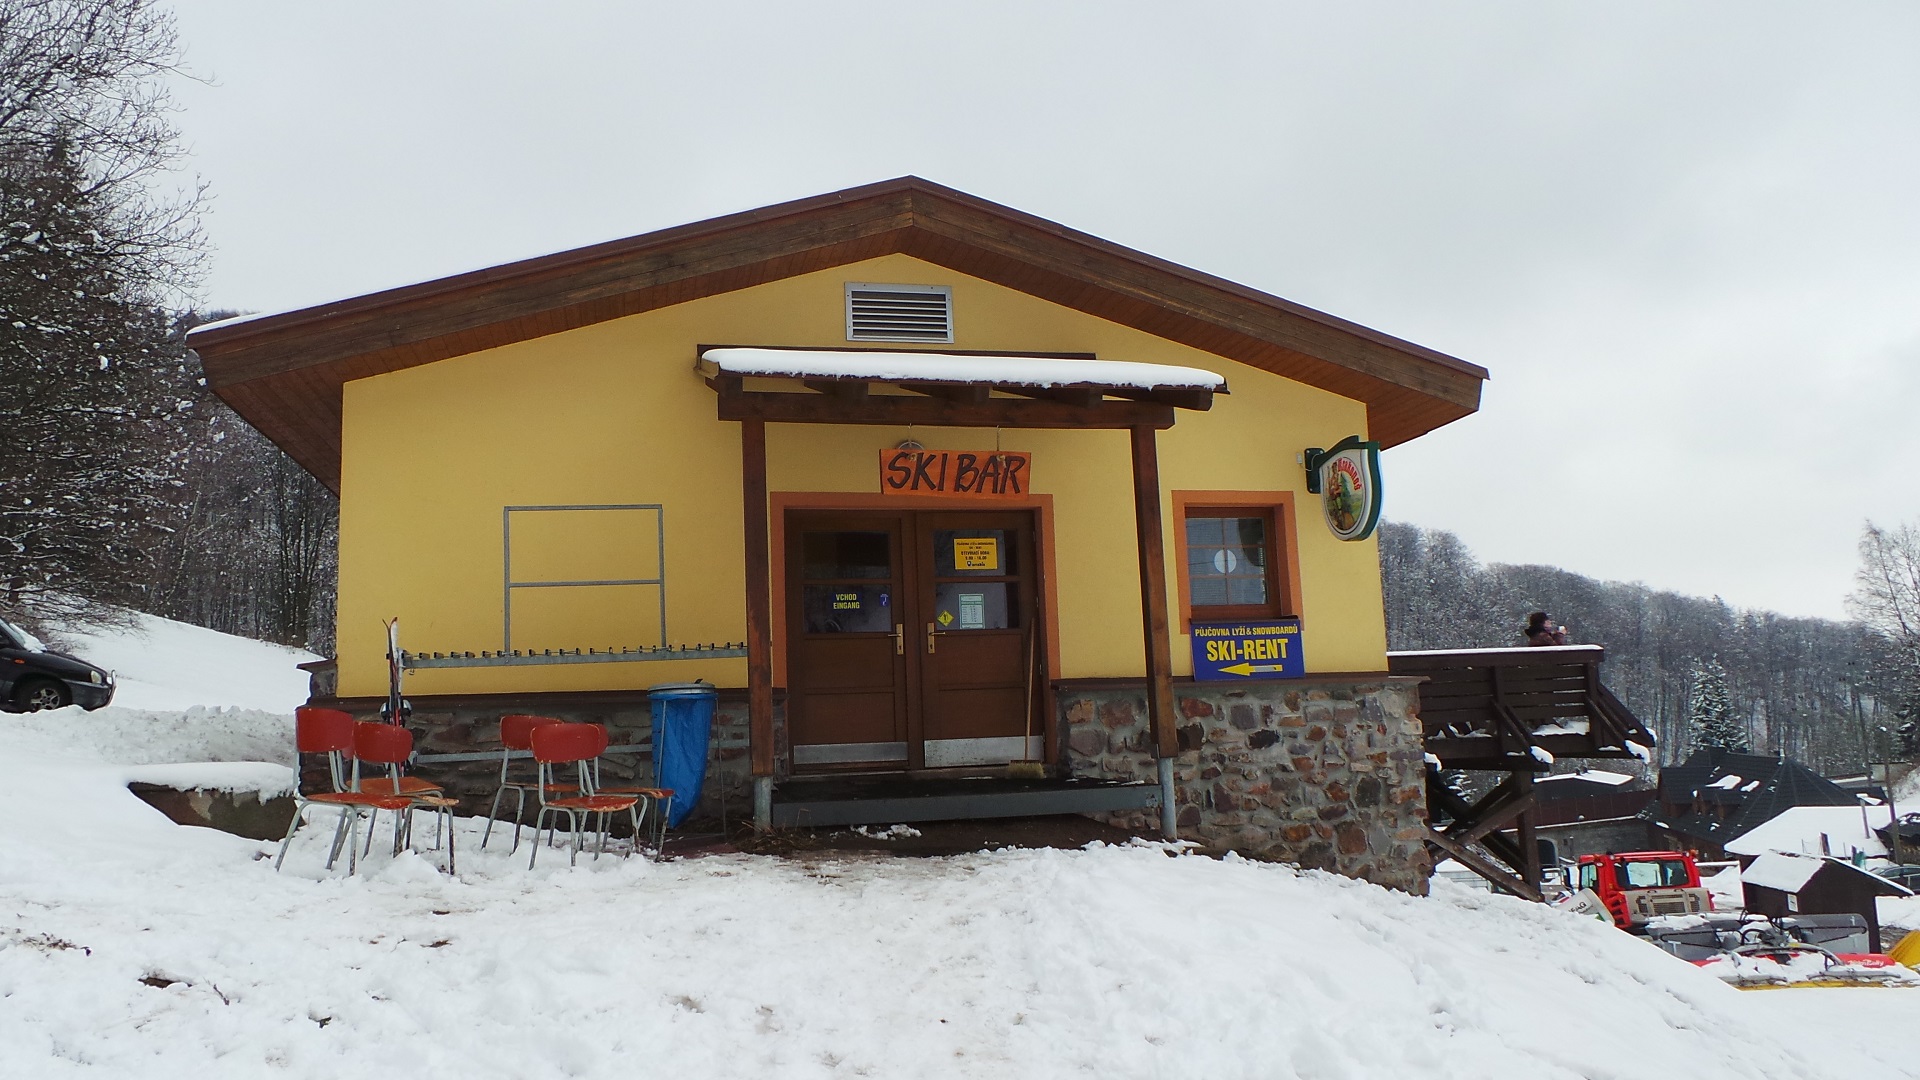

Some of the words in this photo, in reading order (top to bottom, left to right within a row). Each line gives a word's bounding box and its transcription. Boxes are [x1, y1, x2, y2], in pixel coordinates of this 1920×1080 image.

[887, 451, 948, 491] SKI
[954, 453, 1026, 494] BAR
[835, 593, 857, 601] VCHOD
[1195, 626, 1230, 637] PŮJČOVNA
[1232, 626, 1245, 636] LYŽÍ
[1252, 624, 1298, 636] SNOWBOARDŮ
[1206, 638, 1289, 662] SKI-RENT
